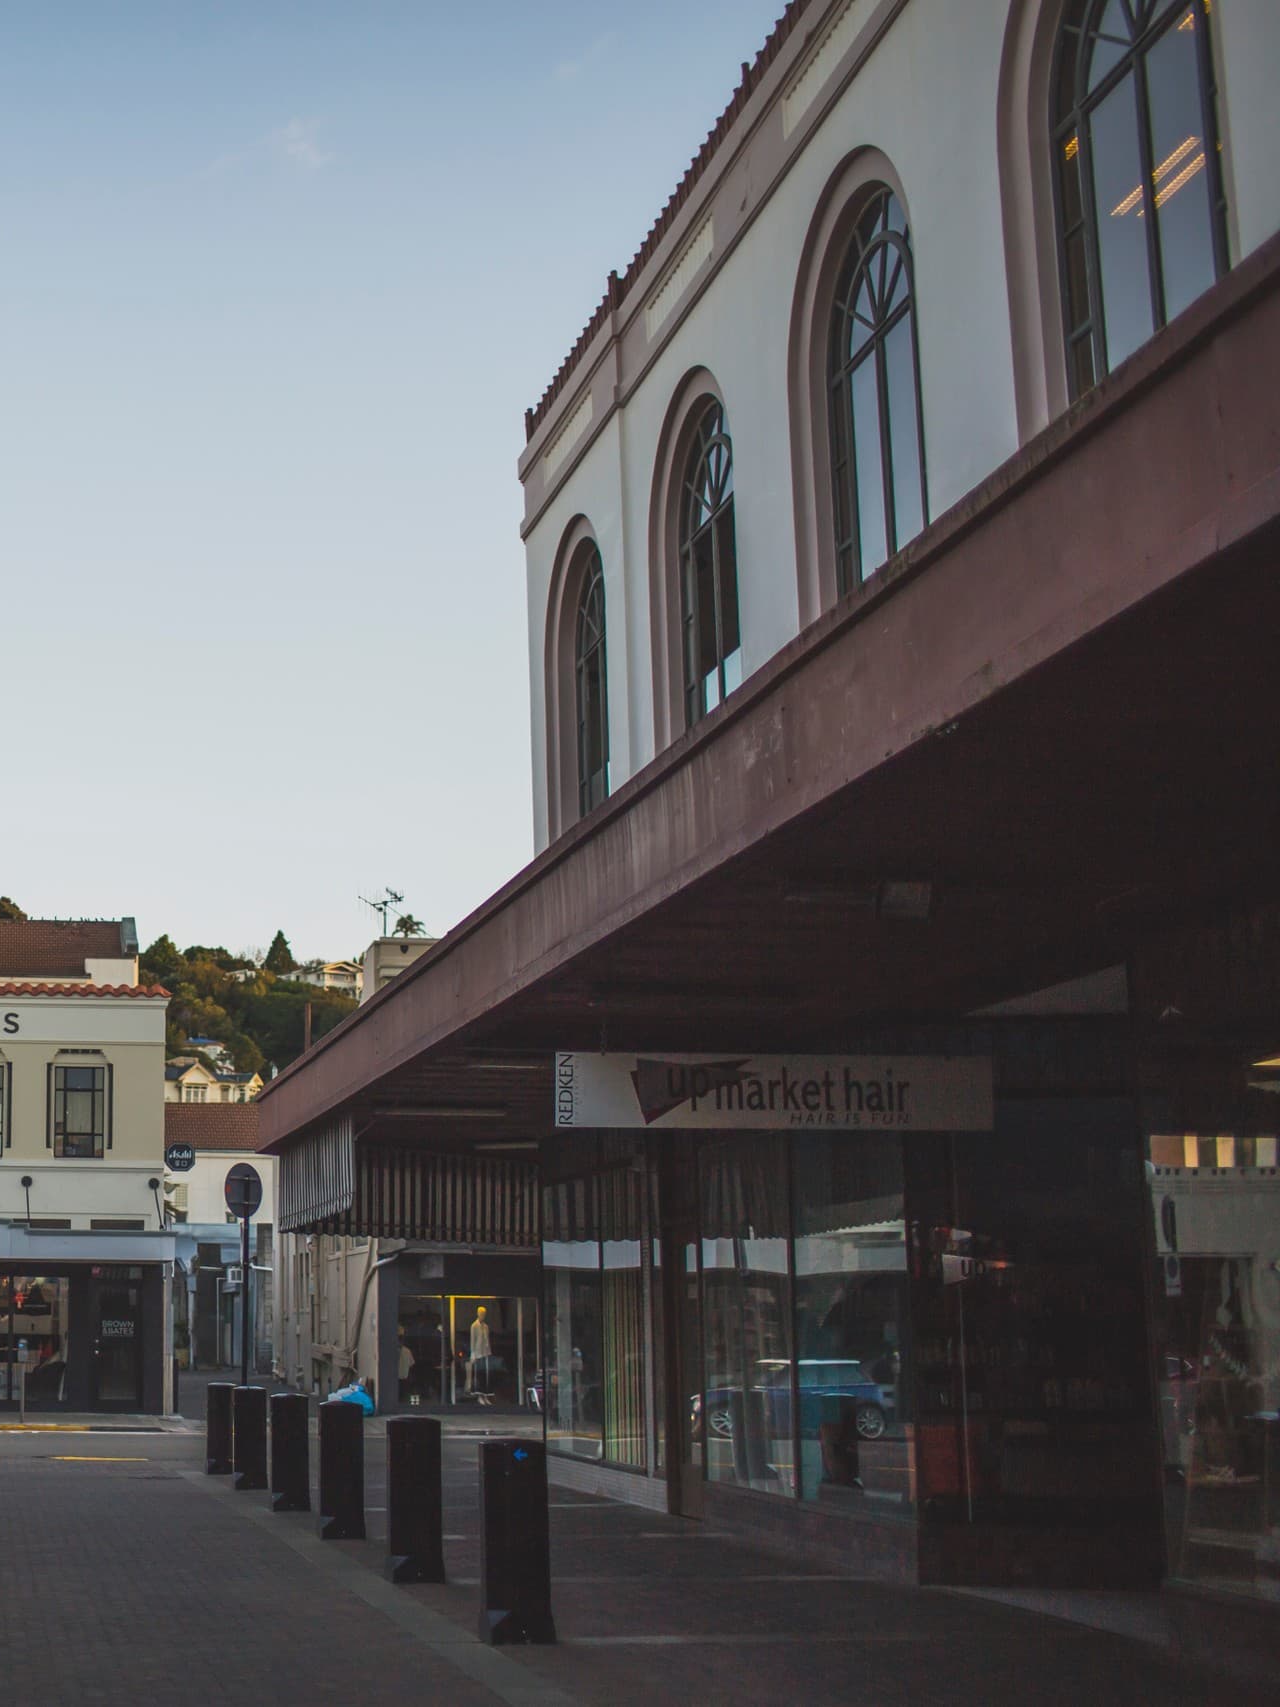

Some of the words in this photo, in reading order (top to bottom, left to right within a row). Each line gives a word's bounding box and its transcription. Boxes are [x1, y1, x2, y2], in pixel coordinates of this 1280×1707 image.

[558, 1054, 574, 1126] REDKEN
[845, 1066, 910, 1112] hair
[790, 1112, 836, 1125] HAIR
[846, 1112, 862, 1125] IS
[871, 1113, 912, 1126] FUN
[102, 1320, 135, 1328] BROWN
